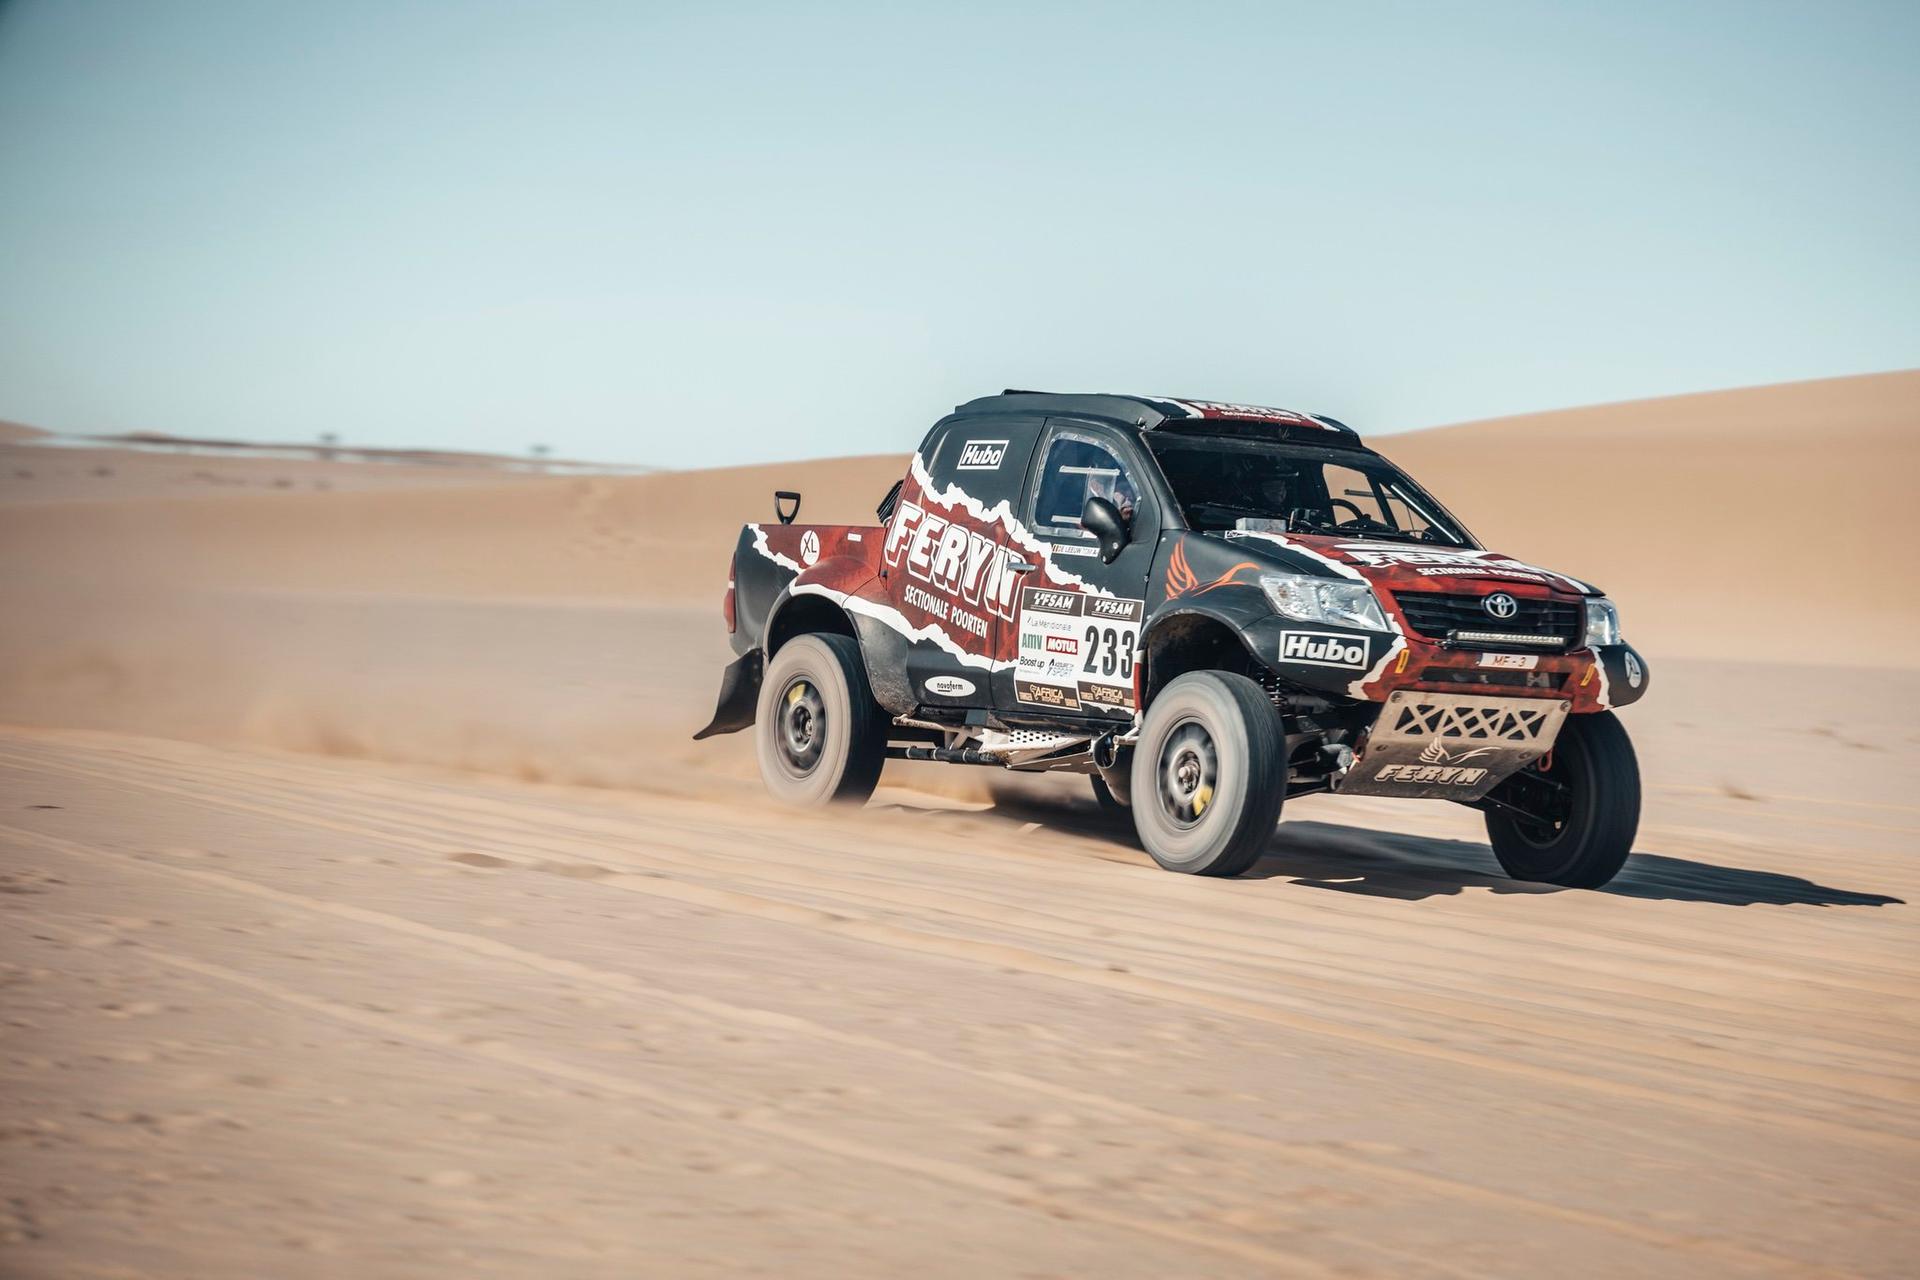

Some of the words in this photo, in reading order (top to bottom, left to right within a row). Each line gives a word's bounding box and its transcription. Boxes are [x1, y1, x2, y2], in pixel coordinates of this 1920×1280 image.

[963, 445, 1001, 466] Hubo
[802, 533, 817, 556] XL
[884, 500, 1027, 622] FERYN
[904, 584, 949, 620] SECTIONALE
[951, 607, 988, 638] POORTEN
[1047, 637, 1077, 654] MOTUL
[1083, 625, 1135, 679] 233
[1284, 636, 1363, 664] Hubo
[1020, 656, 1036, 667] Boost
[937, 681, 963, 692] novoferm
[1375, 764, 1487, 786] FERYN
